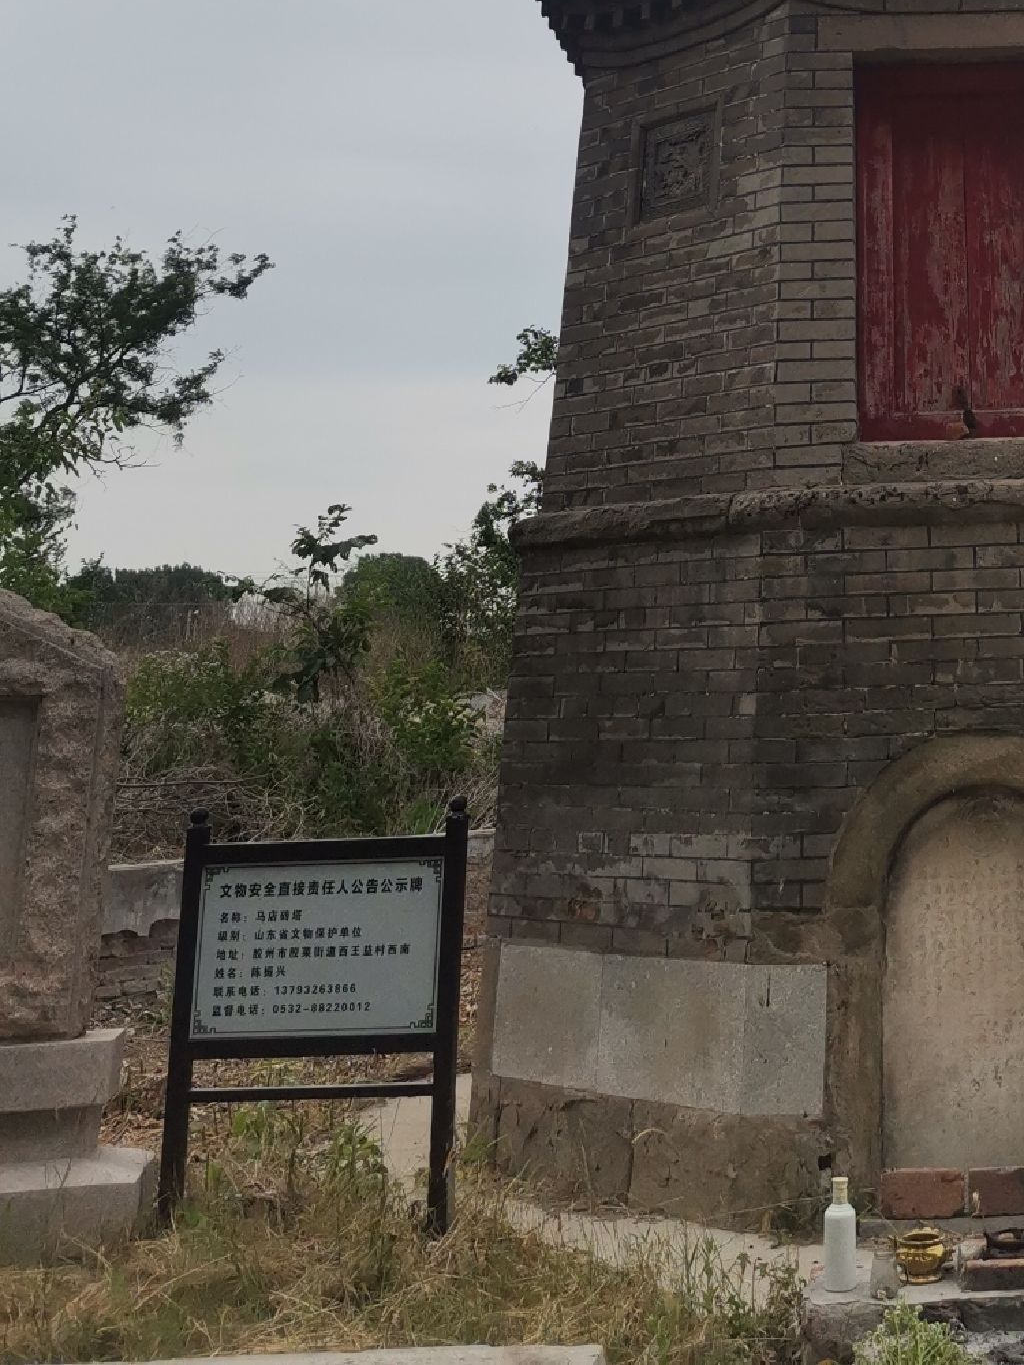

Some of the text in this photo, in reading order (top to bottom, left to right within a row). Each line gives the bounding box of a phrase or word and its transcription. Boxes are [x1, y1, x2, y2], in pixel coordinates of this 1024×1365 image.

[220, 877, 423, 898] 文物安全直接责任人公告公示牌
